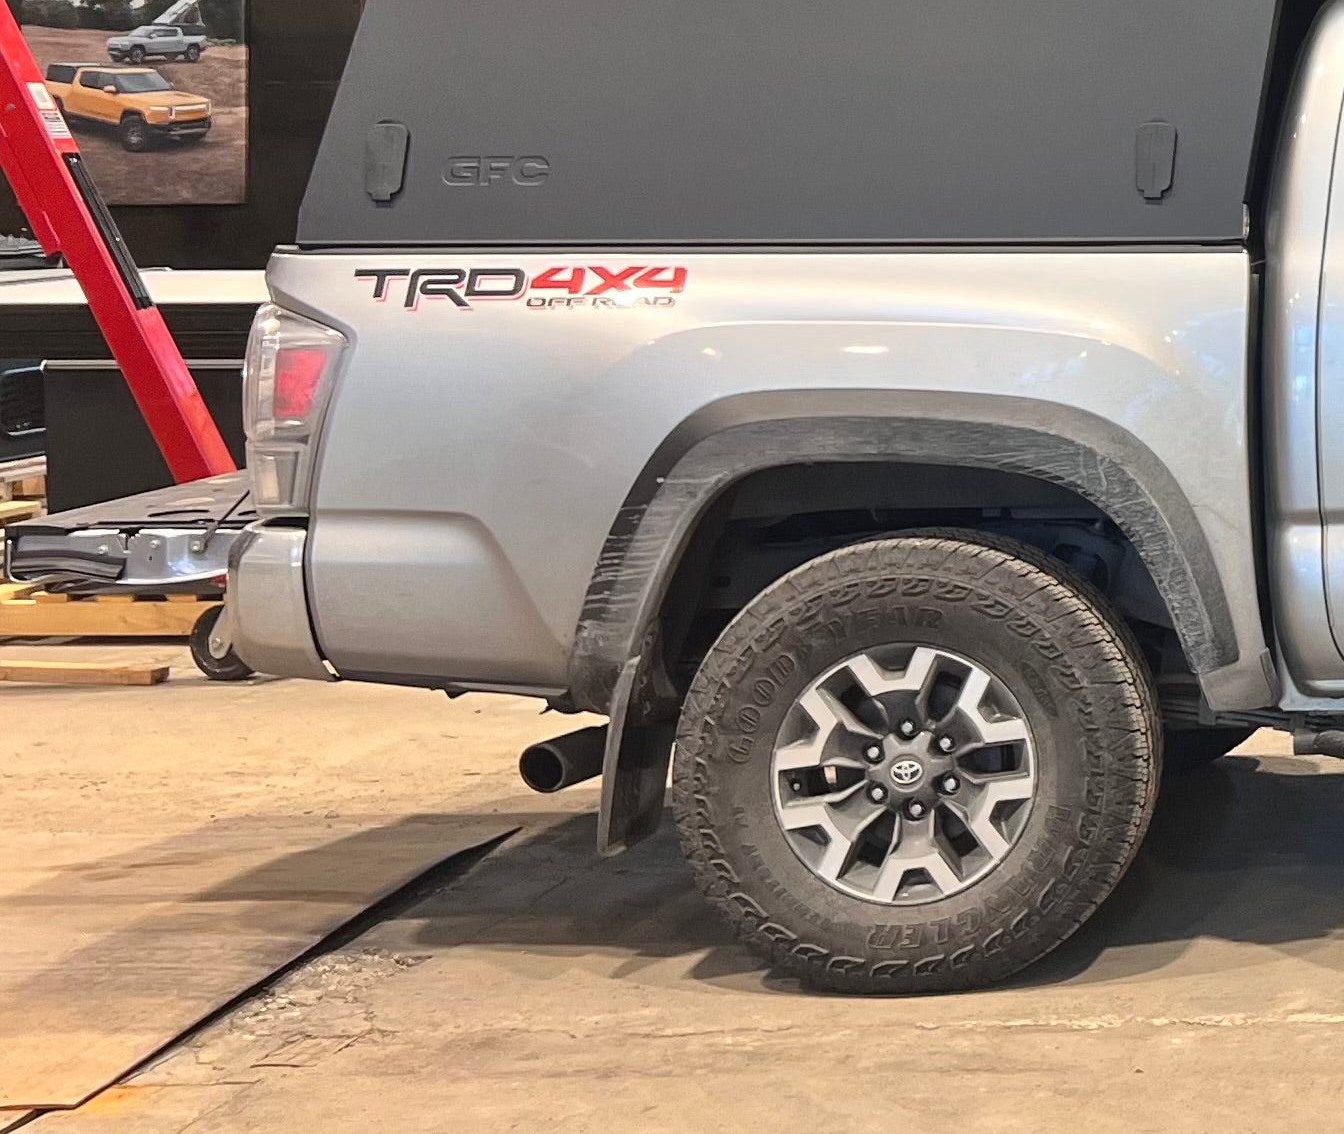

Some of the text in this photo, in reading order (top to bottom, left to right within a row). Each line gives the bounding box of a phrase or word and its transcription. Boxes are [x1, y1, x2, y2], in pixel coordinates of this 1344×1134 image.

[441, 155, 549, 186] GFC
[354, 267, 527, 310] TRD
[526, 296, 673, 309] OFF RAD
